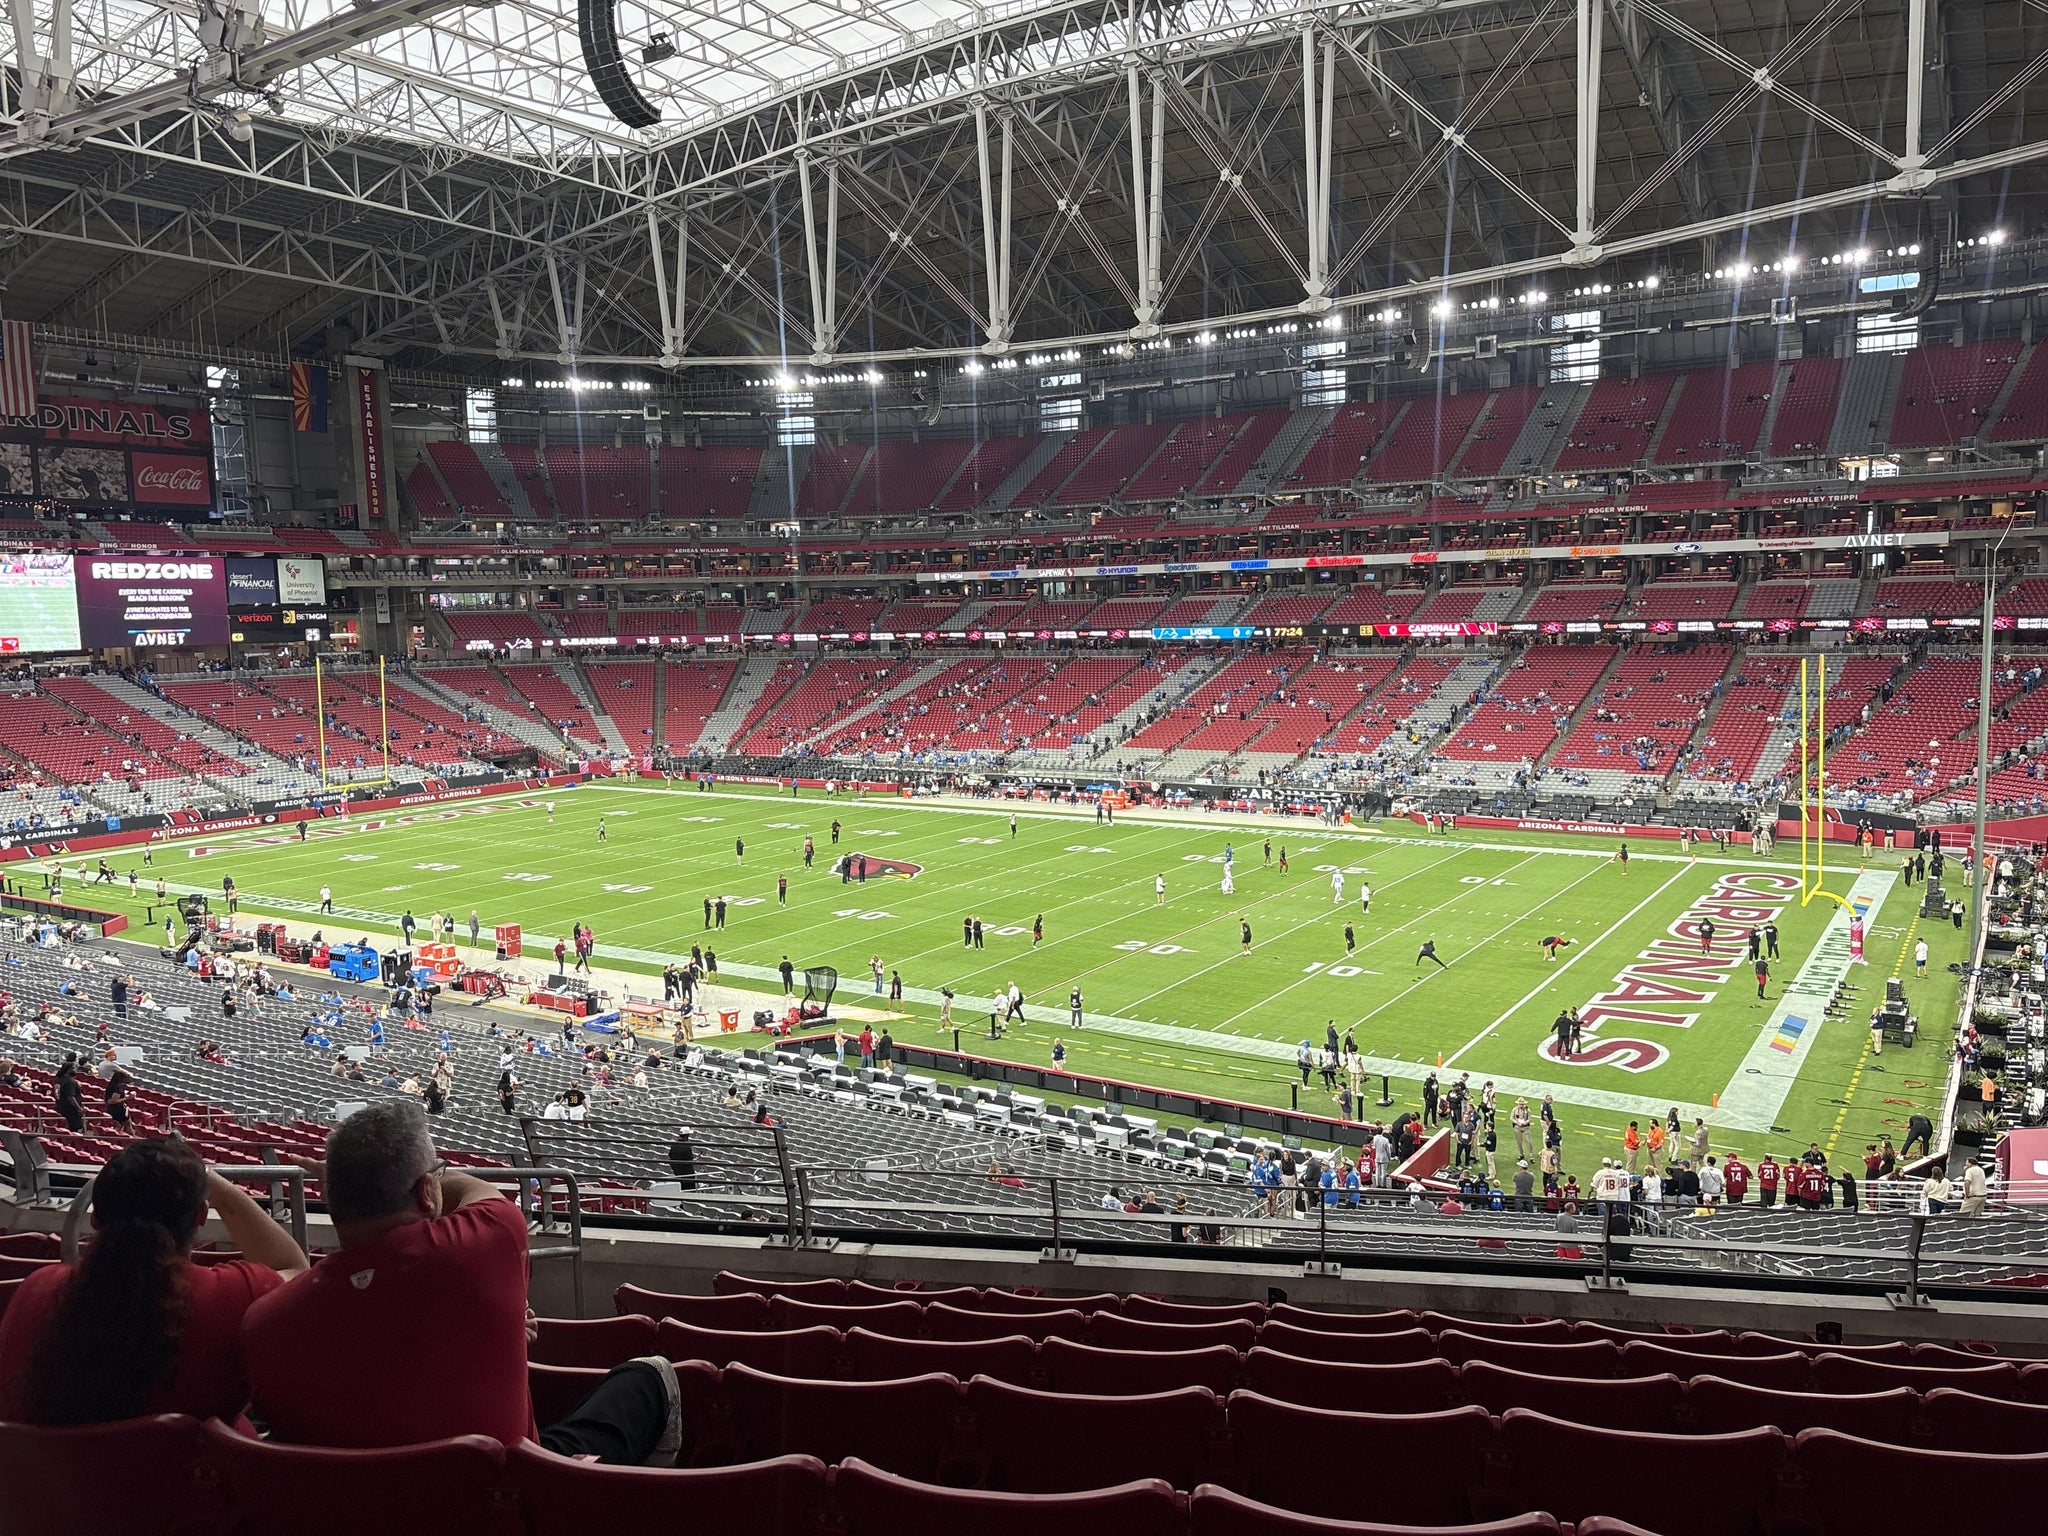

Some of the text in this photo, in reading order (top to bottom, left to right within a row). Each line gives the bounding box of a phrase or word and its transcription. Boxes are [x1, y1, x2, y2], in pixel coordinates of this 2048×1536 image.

[363, 384, 379, 514] ESTABLISHED 1898
[1783, 496, 1825, 504] CHARLEY
[1828, 494, 1858, 502] TRIPPI
[1845, 533, 1905, 547] AVNET
[1506, 548, 1531, 556] RIVER
[1677, 544, 1698, 552] Ford
[91, 562, 214, 580] REDZONE
[1037, 568, 1066, 577] SAFEWAY
[1163, 563, 1198, 573] Spectrum
[229, 572, 253, 580] desert
[286, 581, 316, 589] University
[237, 613, 273, 623] verizon
[1800, 619, 1820, 627] desert
[1931, 618, 1951, 626] desert
[1389, 623, 1461, 635] 0 CARDINALS
[1717, 620, 1736, 628] desert
[1189, 628, 1213, 636] LIONS
[1233, 628, 1241, 637] 0
[135, 632, 186, 646] AVNET
[681, 635, 687, 643] 3
[723, 635, 730, 643] 2
[716, 774, 780, 784] ARIZONA CARDINAL
[274, 792, 355, 808] ARIZONA CARDINS
[399, 788, 482, 805] ARIZONA CARDINALS
[203, 817, 261, 831] CARDINALS
[1517, 821, 1626, 834] ARIZONA CARDINALS
[24, 827, 79, 840] CARDINALS
[1112, 940, 1185, 955] 20
[1814, 927, 1852, 961] CRUCIAL
[434, 962, 441, 973] G
[1302, 962, 1365, 977] 10
[1537, 871, 1805, 1074] CARDINALS
[1793, 964, 1842, 997] CATCH
[727, 1015, 736, 1025] G
[569, 1095, 579, 1104] 38
[1730, 1172, 1742, 1182] 14
[1763, 1168, 1774, 1179] 21
[1788, 1172, 1795, 1182] 3
[1605, 1179, 1616, 1190] 18
[1809, 1180, 1819, 1191] 11
